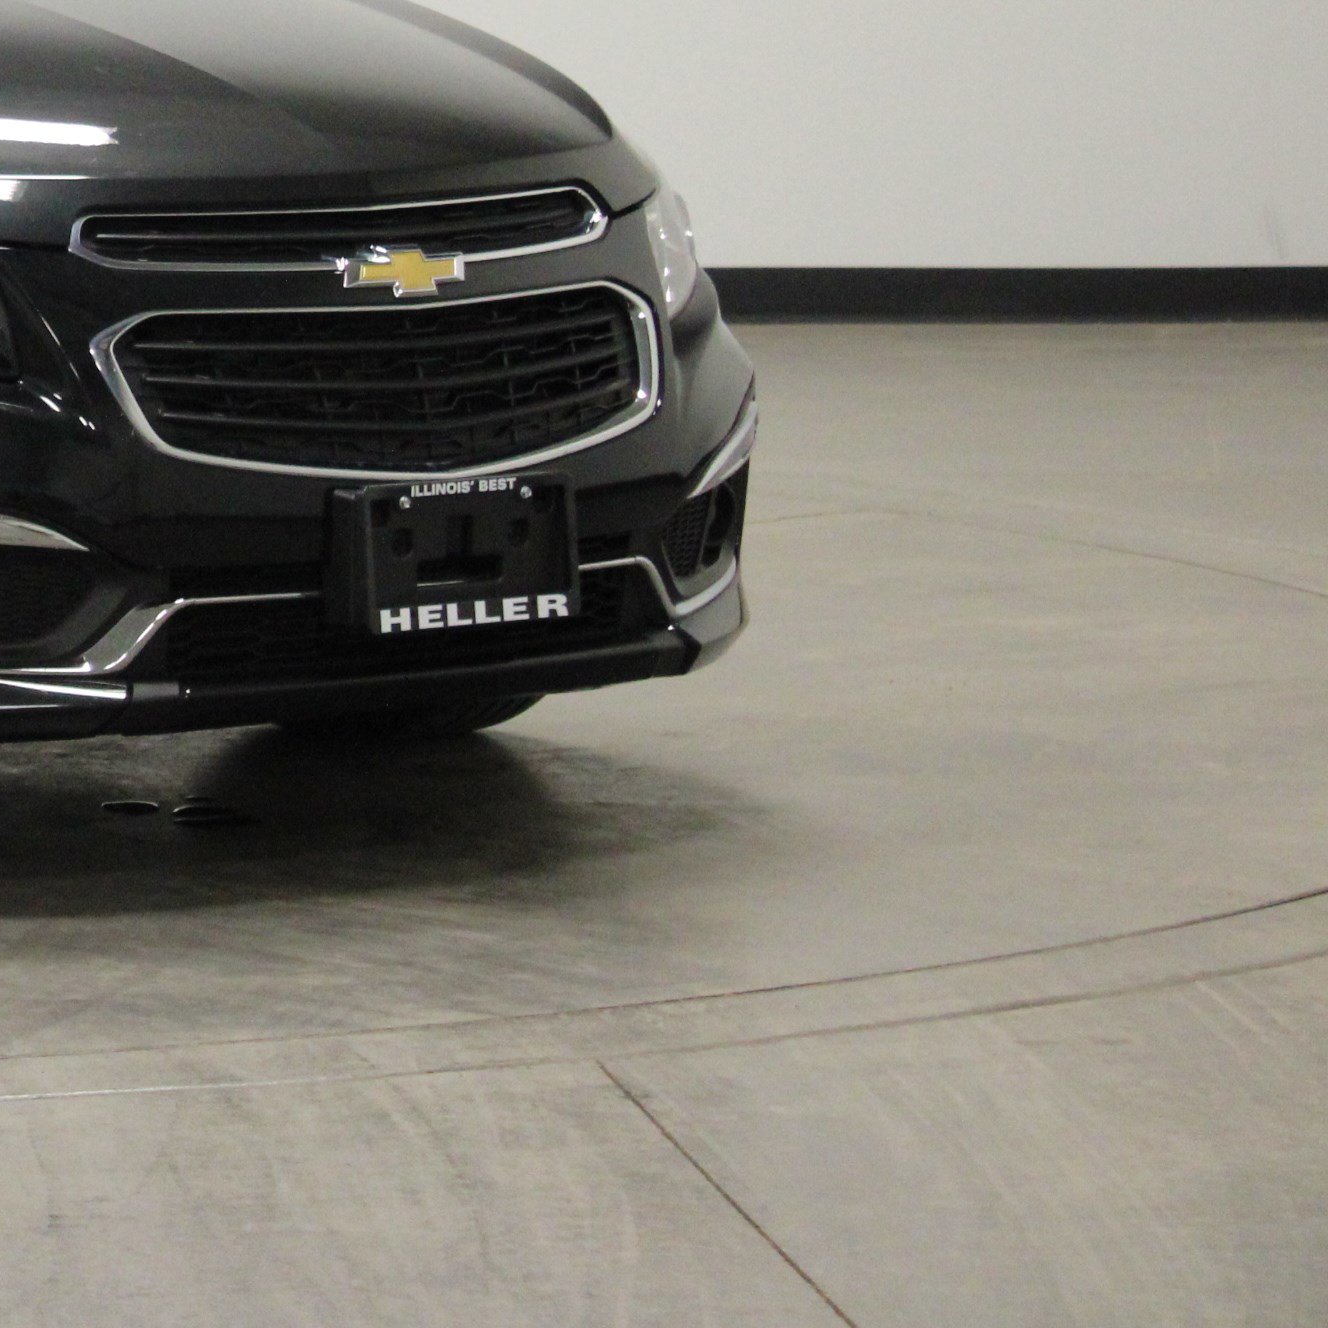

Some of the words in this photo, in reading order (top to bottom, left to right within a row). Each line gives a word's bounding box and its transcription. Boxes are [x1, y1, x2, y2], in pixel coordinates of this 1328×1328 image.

[411, 480, 475, 498] ILLINOIS'
[478, 477, 517, 493] BEST
[380, 593, 569, 634] HELLER
